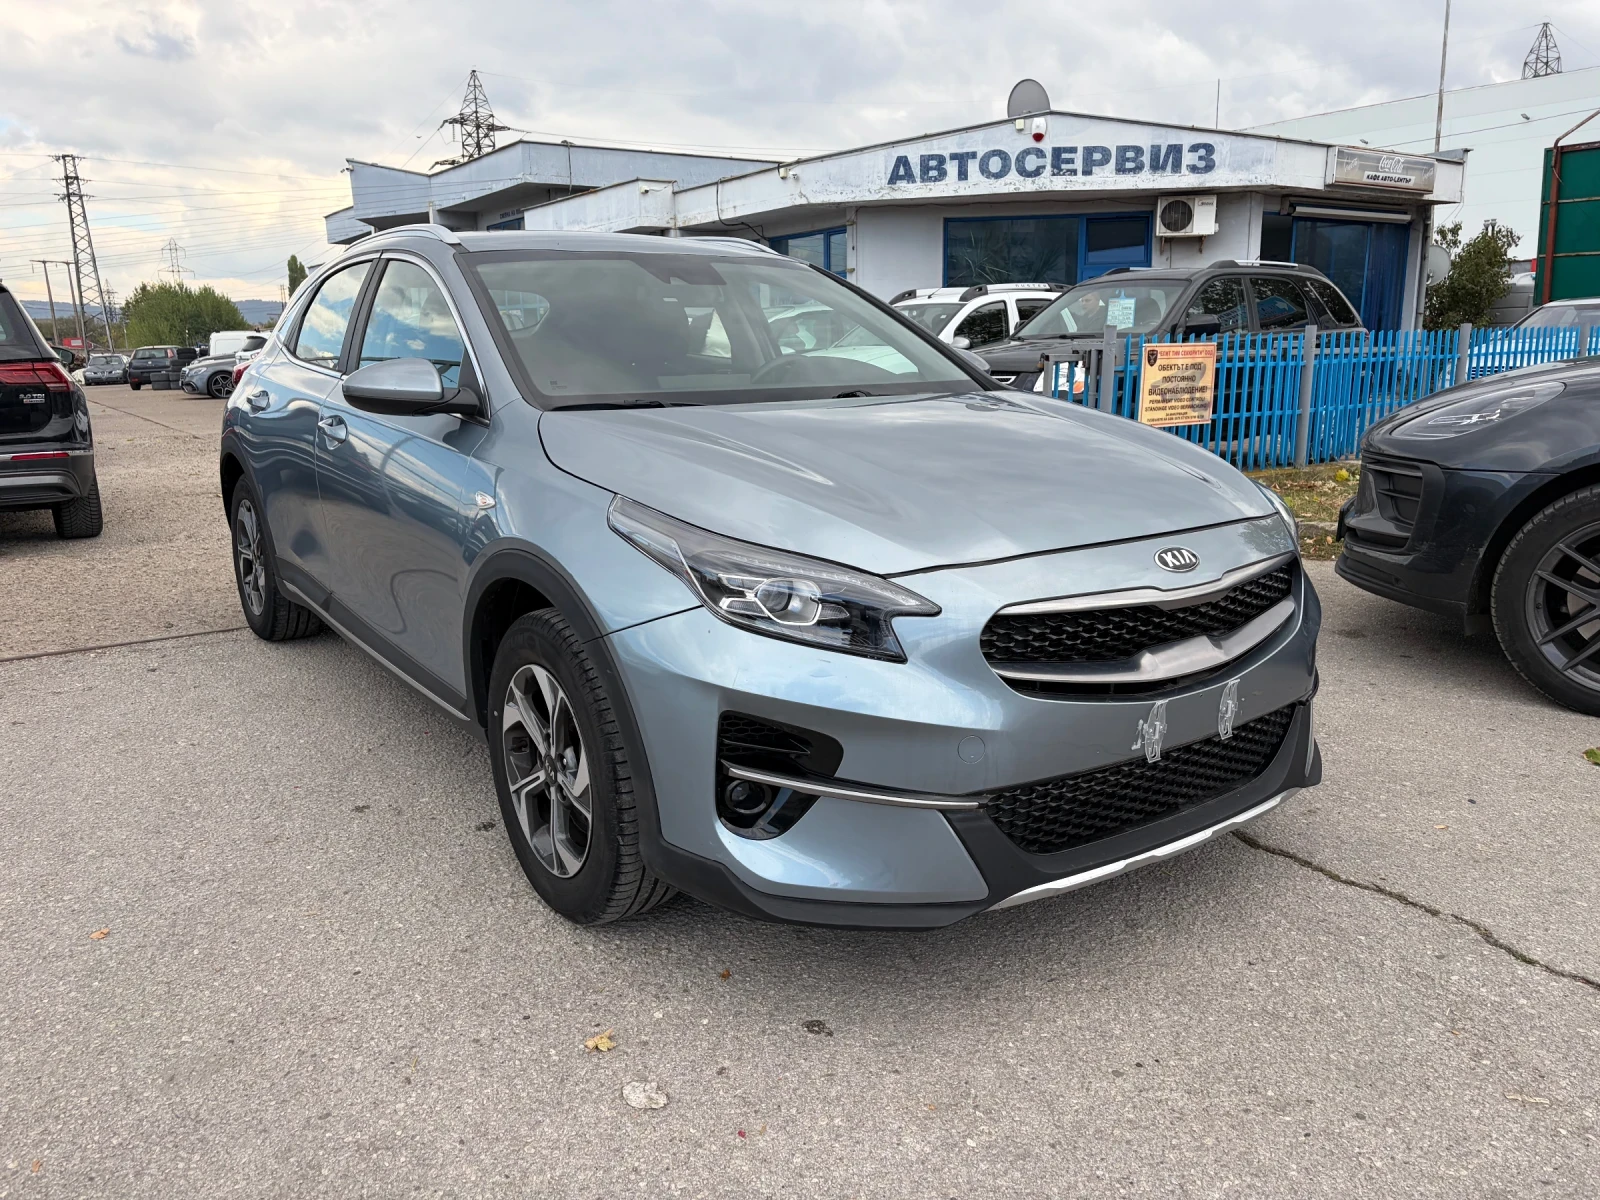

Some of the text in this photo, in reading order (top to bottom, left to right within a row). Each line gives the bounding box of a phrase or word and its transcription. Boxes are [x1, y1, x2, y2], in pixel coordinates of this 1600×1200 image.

[887, 142, 1216, 186] АВТОСЕРВИЗ
[1366, 173, 1380, 182] КАФЕ
[1158, 363, 1202, 372] ОБЕКТЪТ Е ПОД
[1162, 375, 1197, 383] ПОСТОЯННО
[1148, 386, 1208, 396] ВИДЕОНАБЛЮДЕНИЕ!
[1160, 549, 1197, 567] KIA
